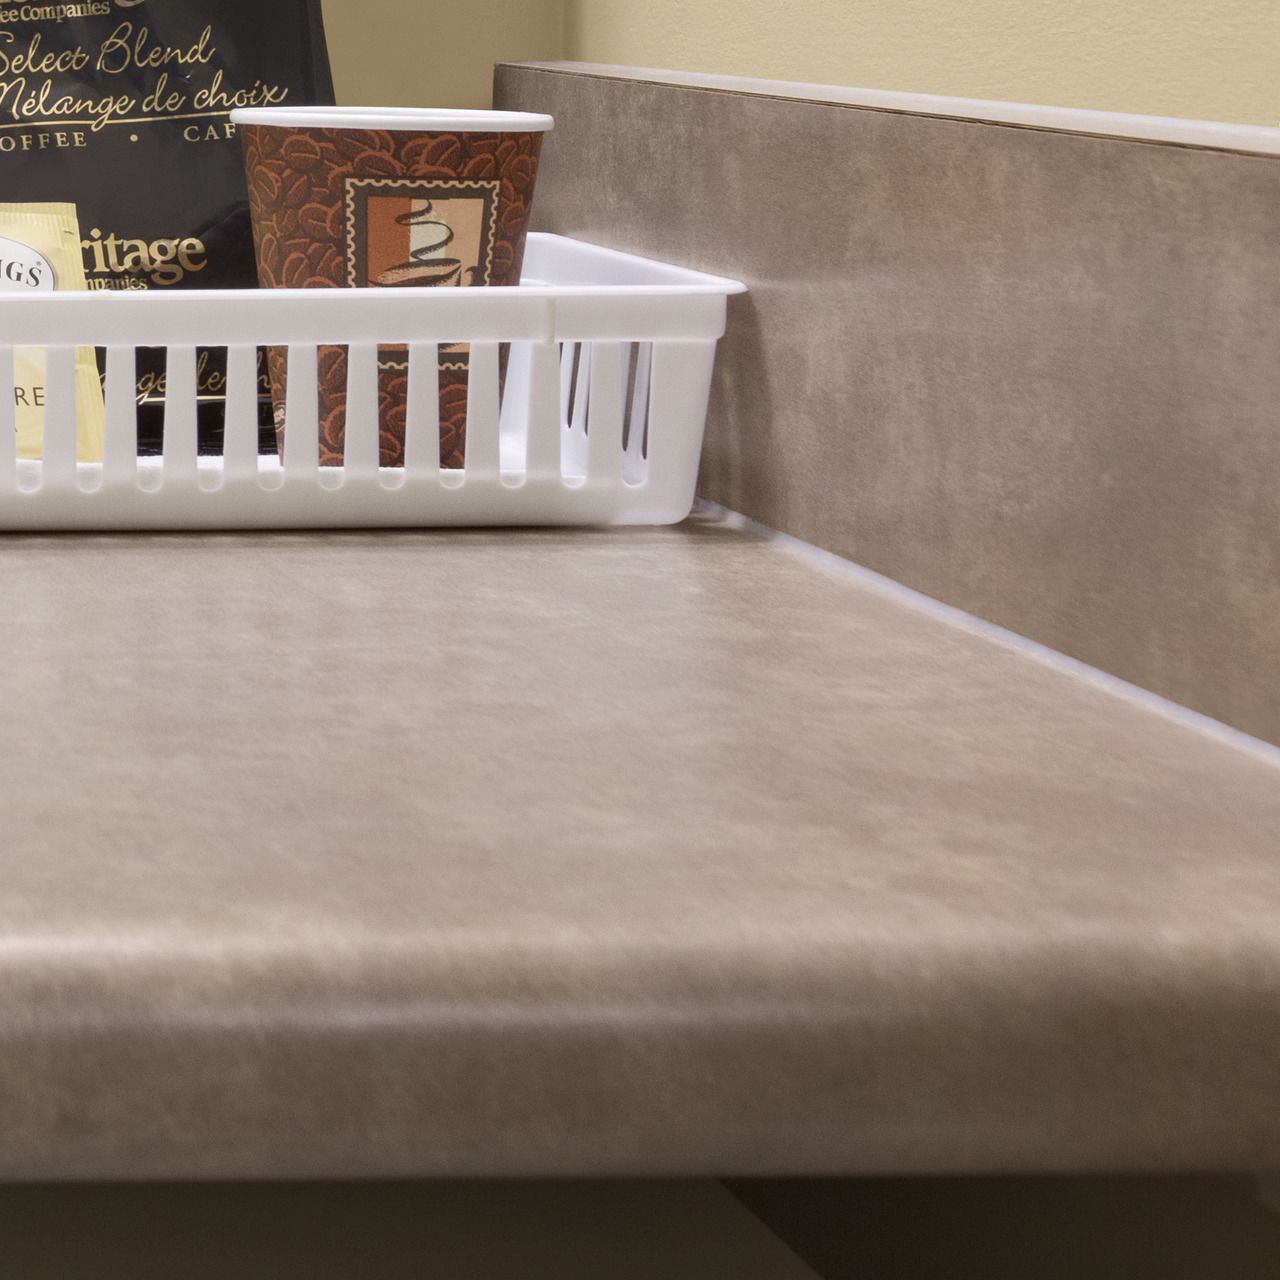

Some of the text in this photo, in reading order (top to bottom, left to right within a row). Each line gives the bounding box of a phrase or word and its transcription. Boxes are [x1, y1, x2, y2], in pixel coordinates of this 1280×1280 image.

[20, 0, 111, 23] Companies
[96, 22, 216, 73] Blend
[142, 72, 186, 113] de
[193, 69, 289, 108] choix
[183, 123, 237, 142] CAF
